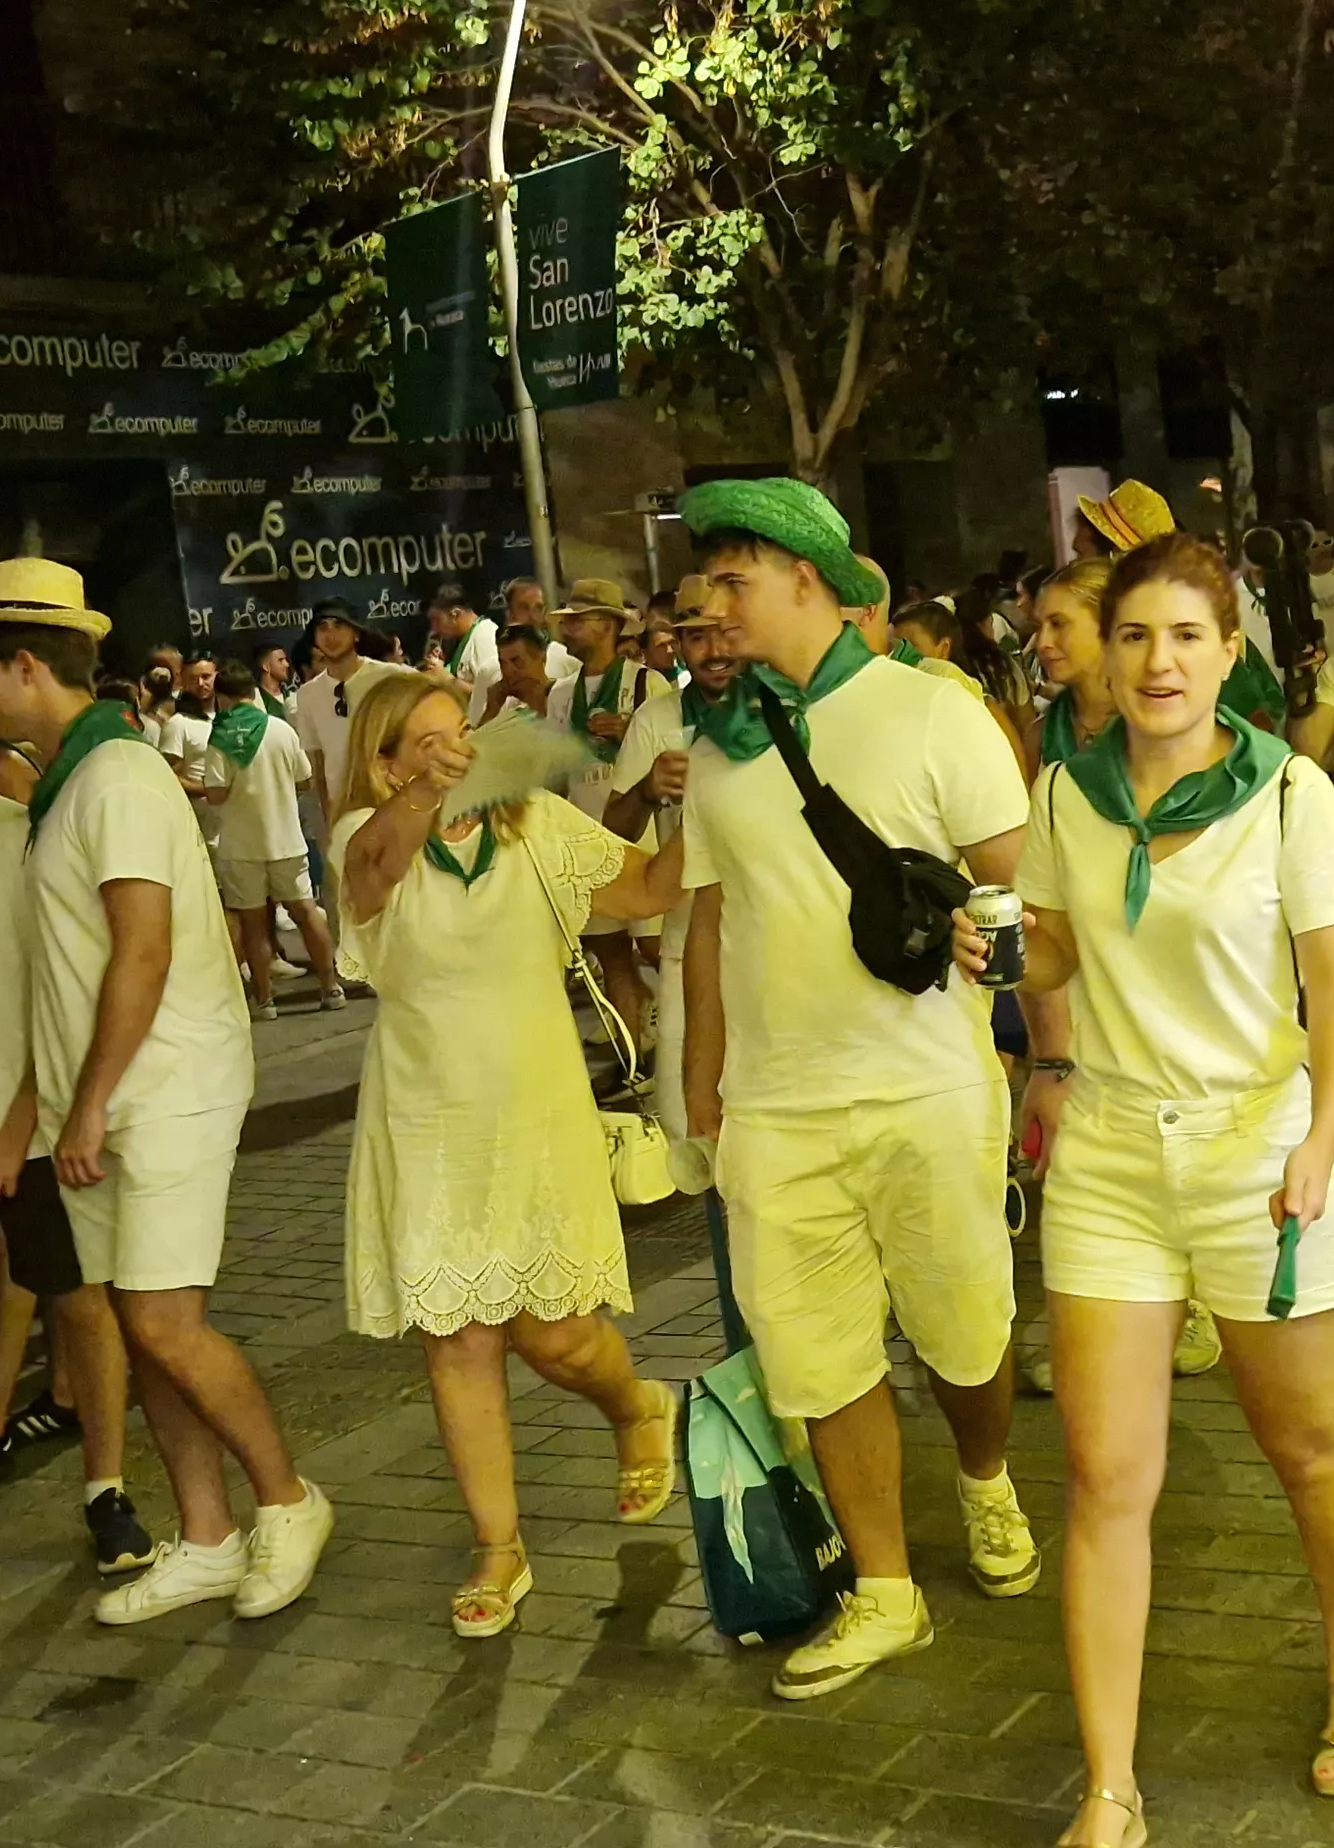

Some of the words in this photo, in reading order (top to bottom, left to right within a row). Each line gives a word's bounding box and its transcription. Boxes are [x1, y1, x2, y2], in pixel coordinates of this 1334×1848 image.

[528, 216, 569, 249] vive
[529, 254, 569, 290] San
[530, 287, 614, 331] Lorenzo
